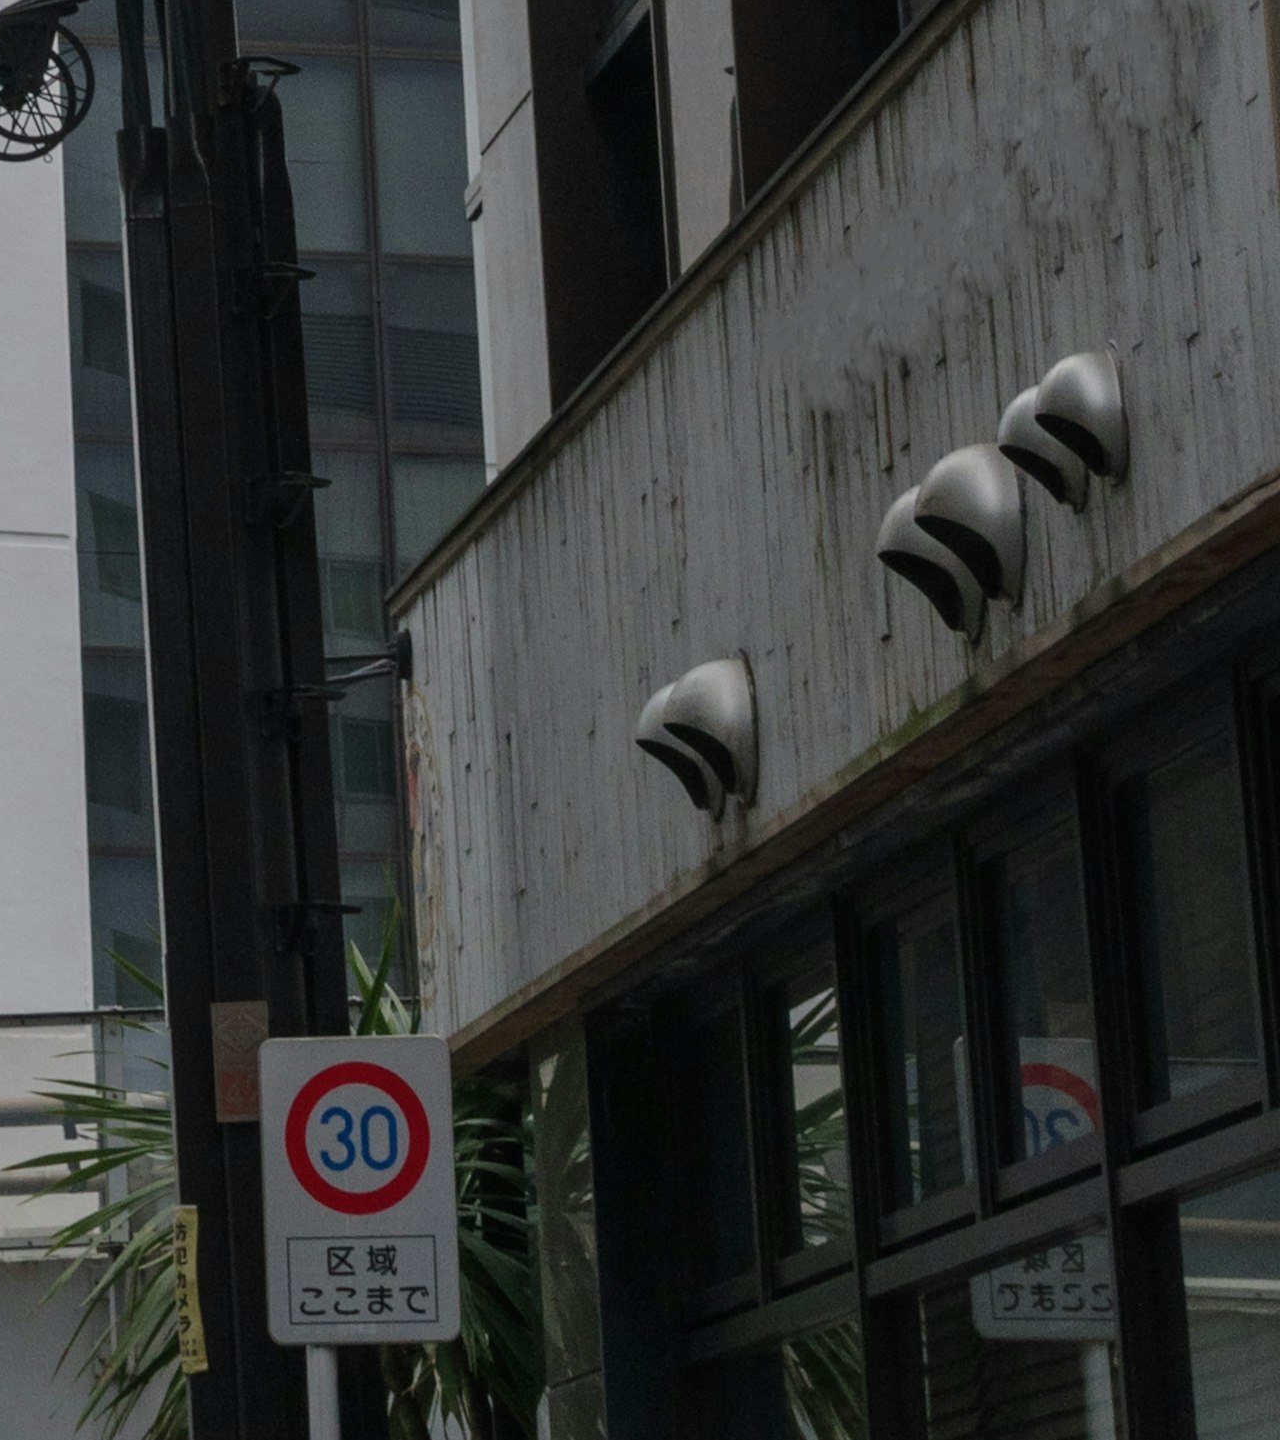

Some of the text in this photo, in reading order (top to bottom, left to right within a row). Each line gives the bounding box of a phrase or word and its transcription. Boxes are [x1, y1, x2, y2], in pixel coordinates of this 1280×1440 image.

[319, 1105, 398, 1171] 30
[327, 1245, 397, 1276] 区域
[298, 1283, 430, 1316] ここまで
